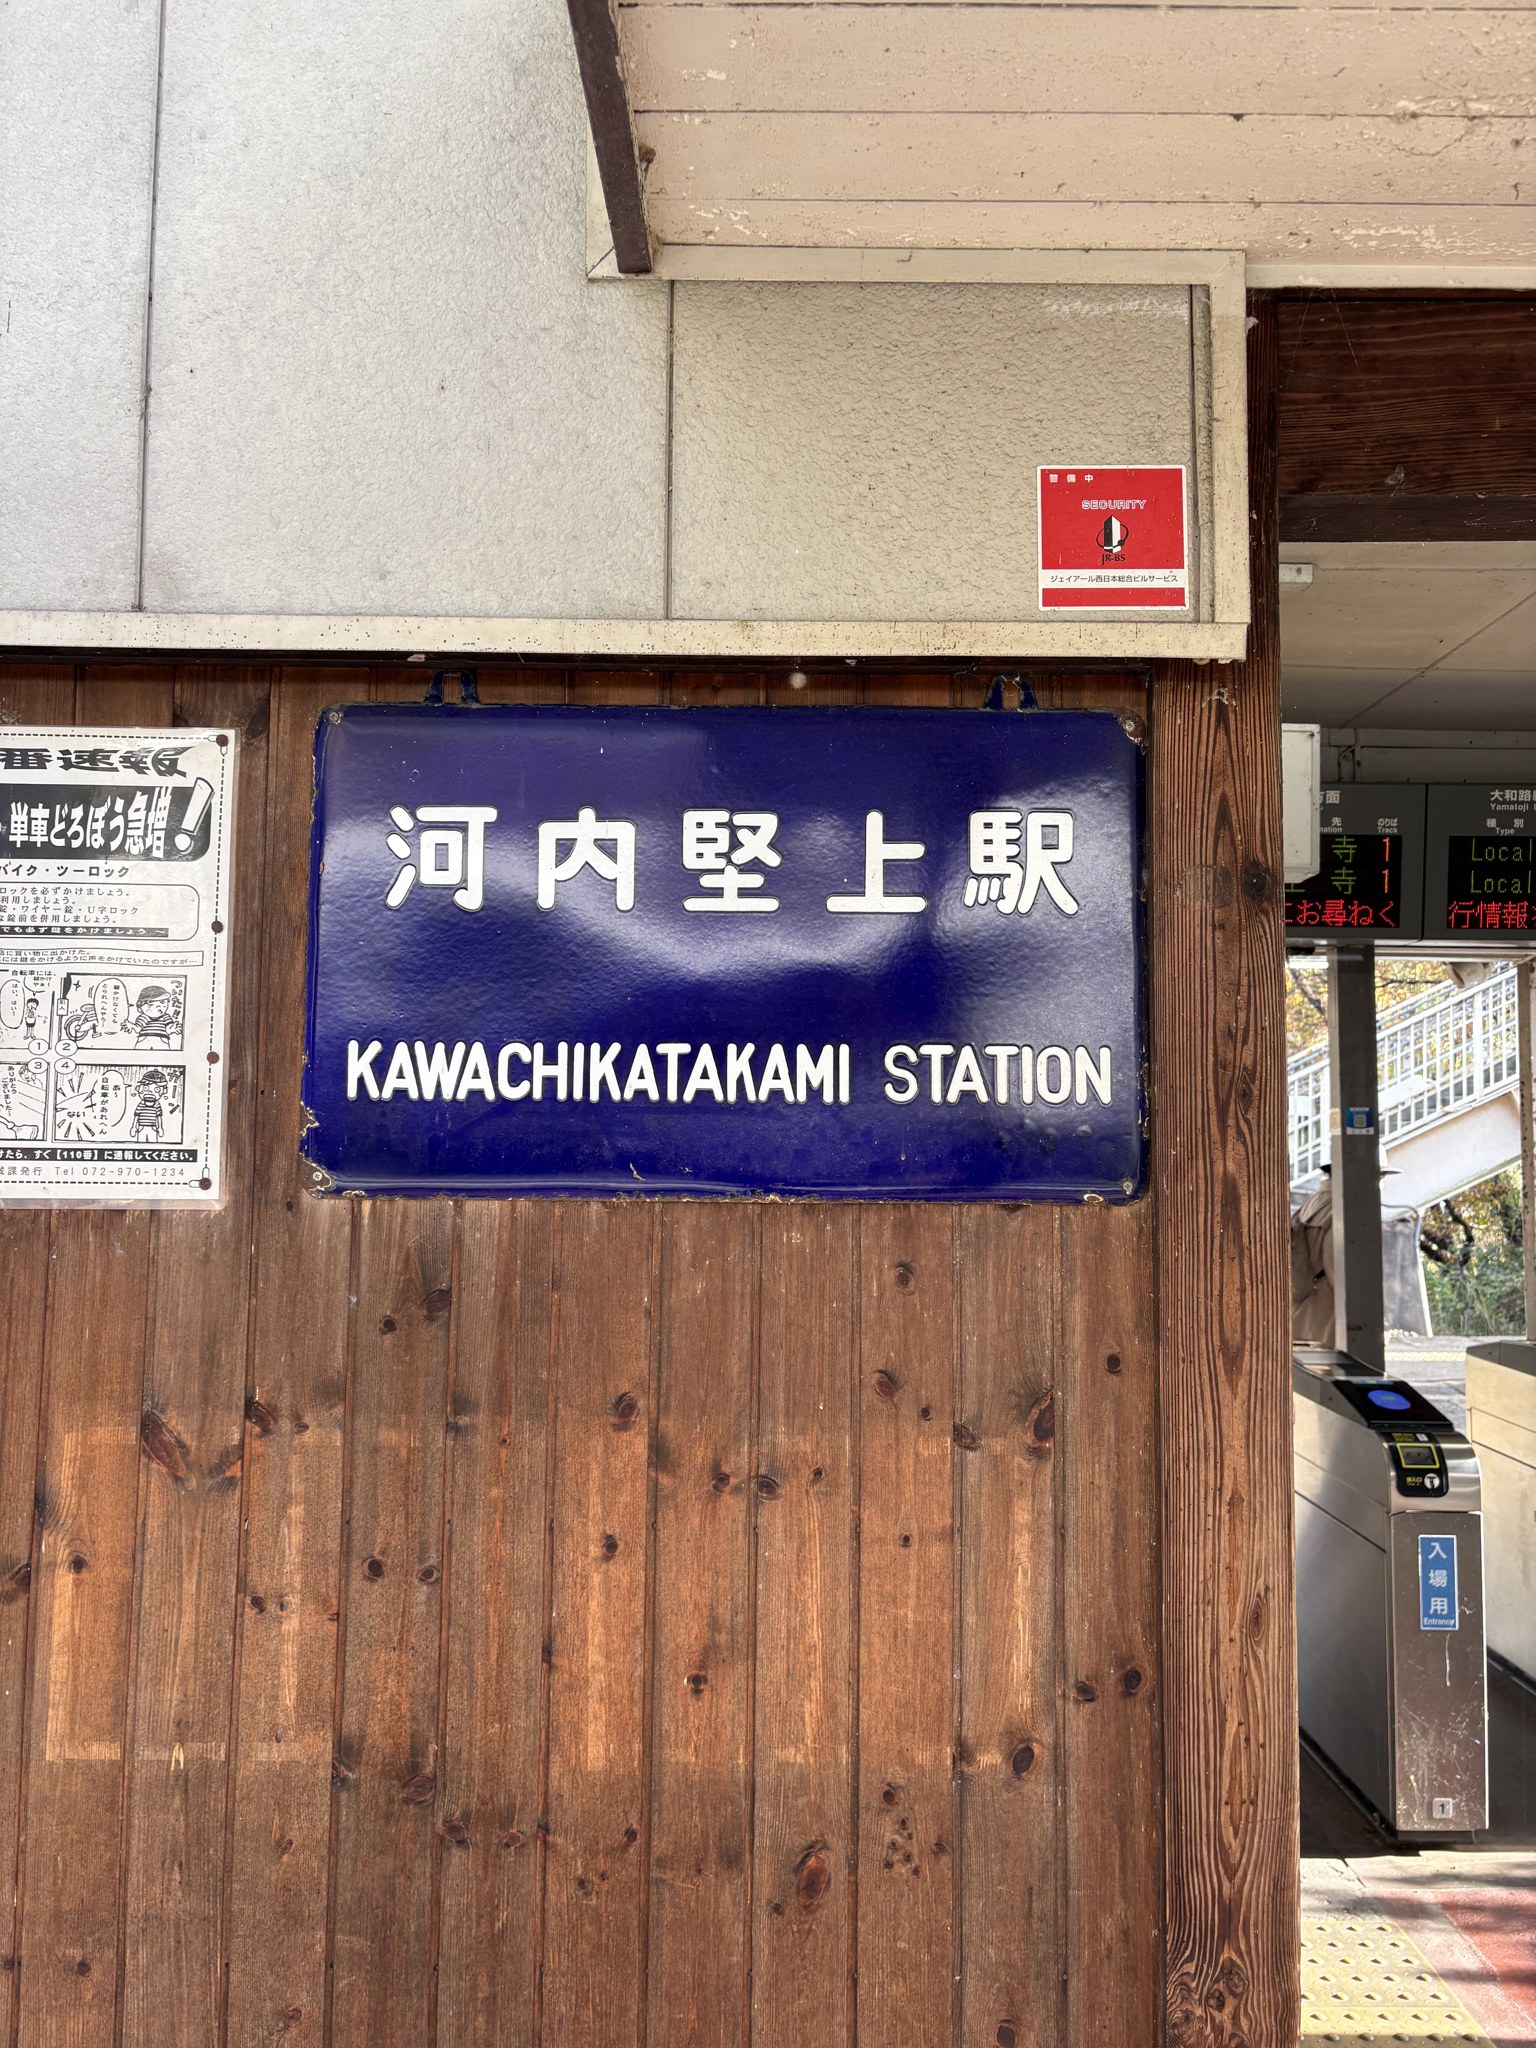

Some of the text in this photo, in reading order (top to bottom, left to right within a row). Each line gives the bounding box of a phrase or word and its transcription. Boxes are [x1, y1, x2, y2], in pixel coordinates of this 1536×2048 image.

[1081, 500, 1147, 510] SECURITY
[1102, 554, 1126, 565] JR-BS
[1050, 574, 1178, 583] ジェイアール西日本総合ビルサービス
[1490, 803, 1529, 812] Yamatoji
[1377, 817, 1398, 827] のりば
[1495, 827, 1515, 836] Type
[1331, 835, 1389, 862] 寺 1
[1472, 838, 1533, 861] Local
[386, 805, 1079, 915] 河内堅上駅
[0, 864, 129, 878] バイク・ツーロック
[1382, 869, 1389, 893] 1
[1471, 870, 1532, 893] Local
[1448, 901, 1536, 928] 行情報
[347, 1039, 1113, 1105] KAWACHIKATAKAMI STATION
[55, 1167, 74, 1176] Tel
[82, 1167, 185, 1177] 072-970-1234
[1428, 1542, 1448, 1615] 入場用
[1439, 1803, 1445, 1815] 1
